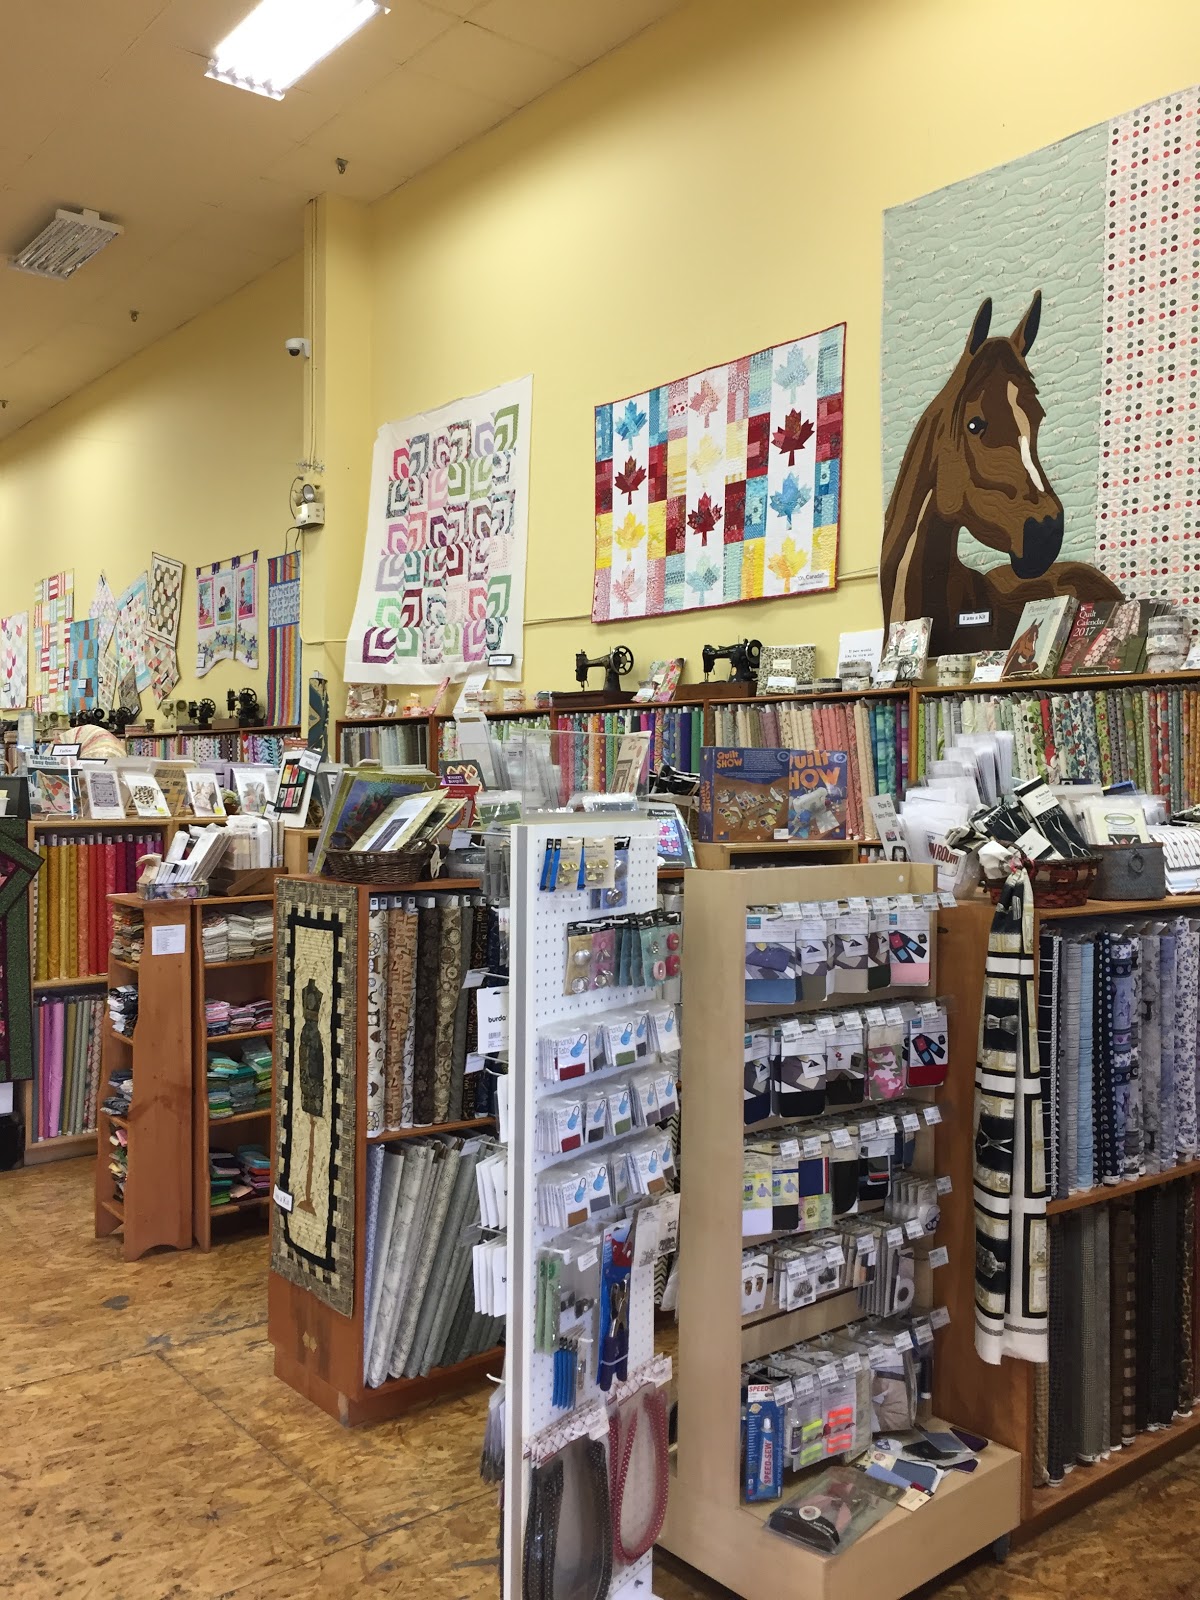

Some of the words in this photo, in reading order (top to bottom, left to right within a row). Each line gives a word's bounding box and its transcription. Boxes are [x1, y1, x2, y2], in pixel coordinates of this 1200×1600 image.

[1079, 610, 1097, 619] Quilt
[1076, 619, 1105, 627] Calendar
[1072, 626, 1096, 637] 2017
[716, 751, 739, 760] Quilt
[789, 750, 831, 769] uilt
[716, 758, 743, 769] SHOW
[487, 1014, 507, 1023] burda
[763, 1442, 772, 1485] SPEED-SEW
